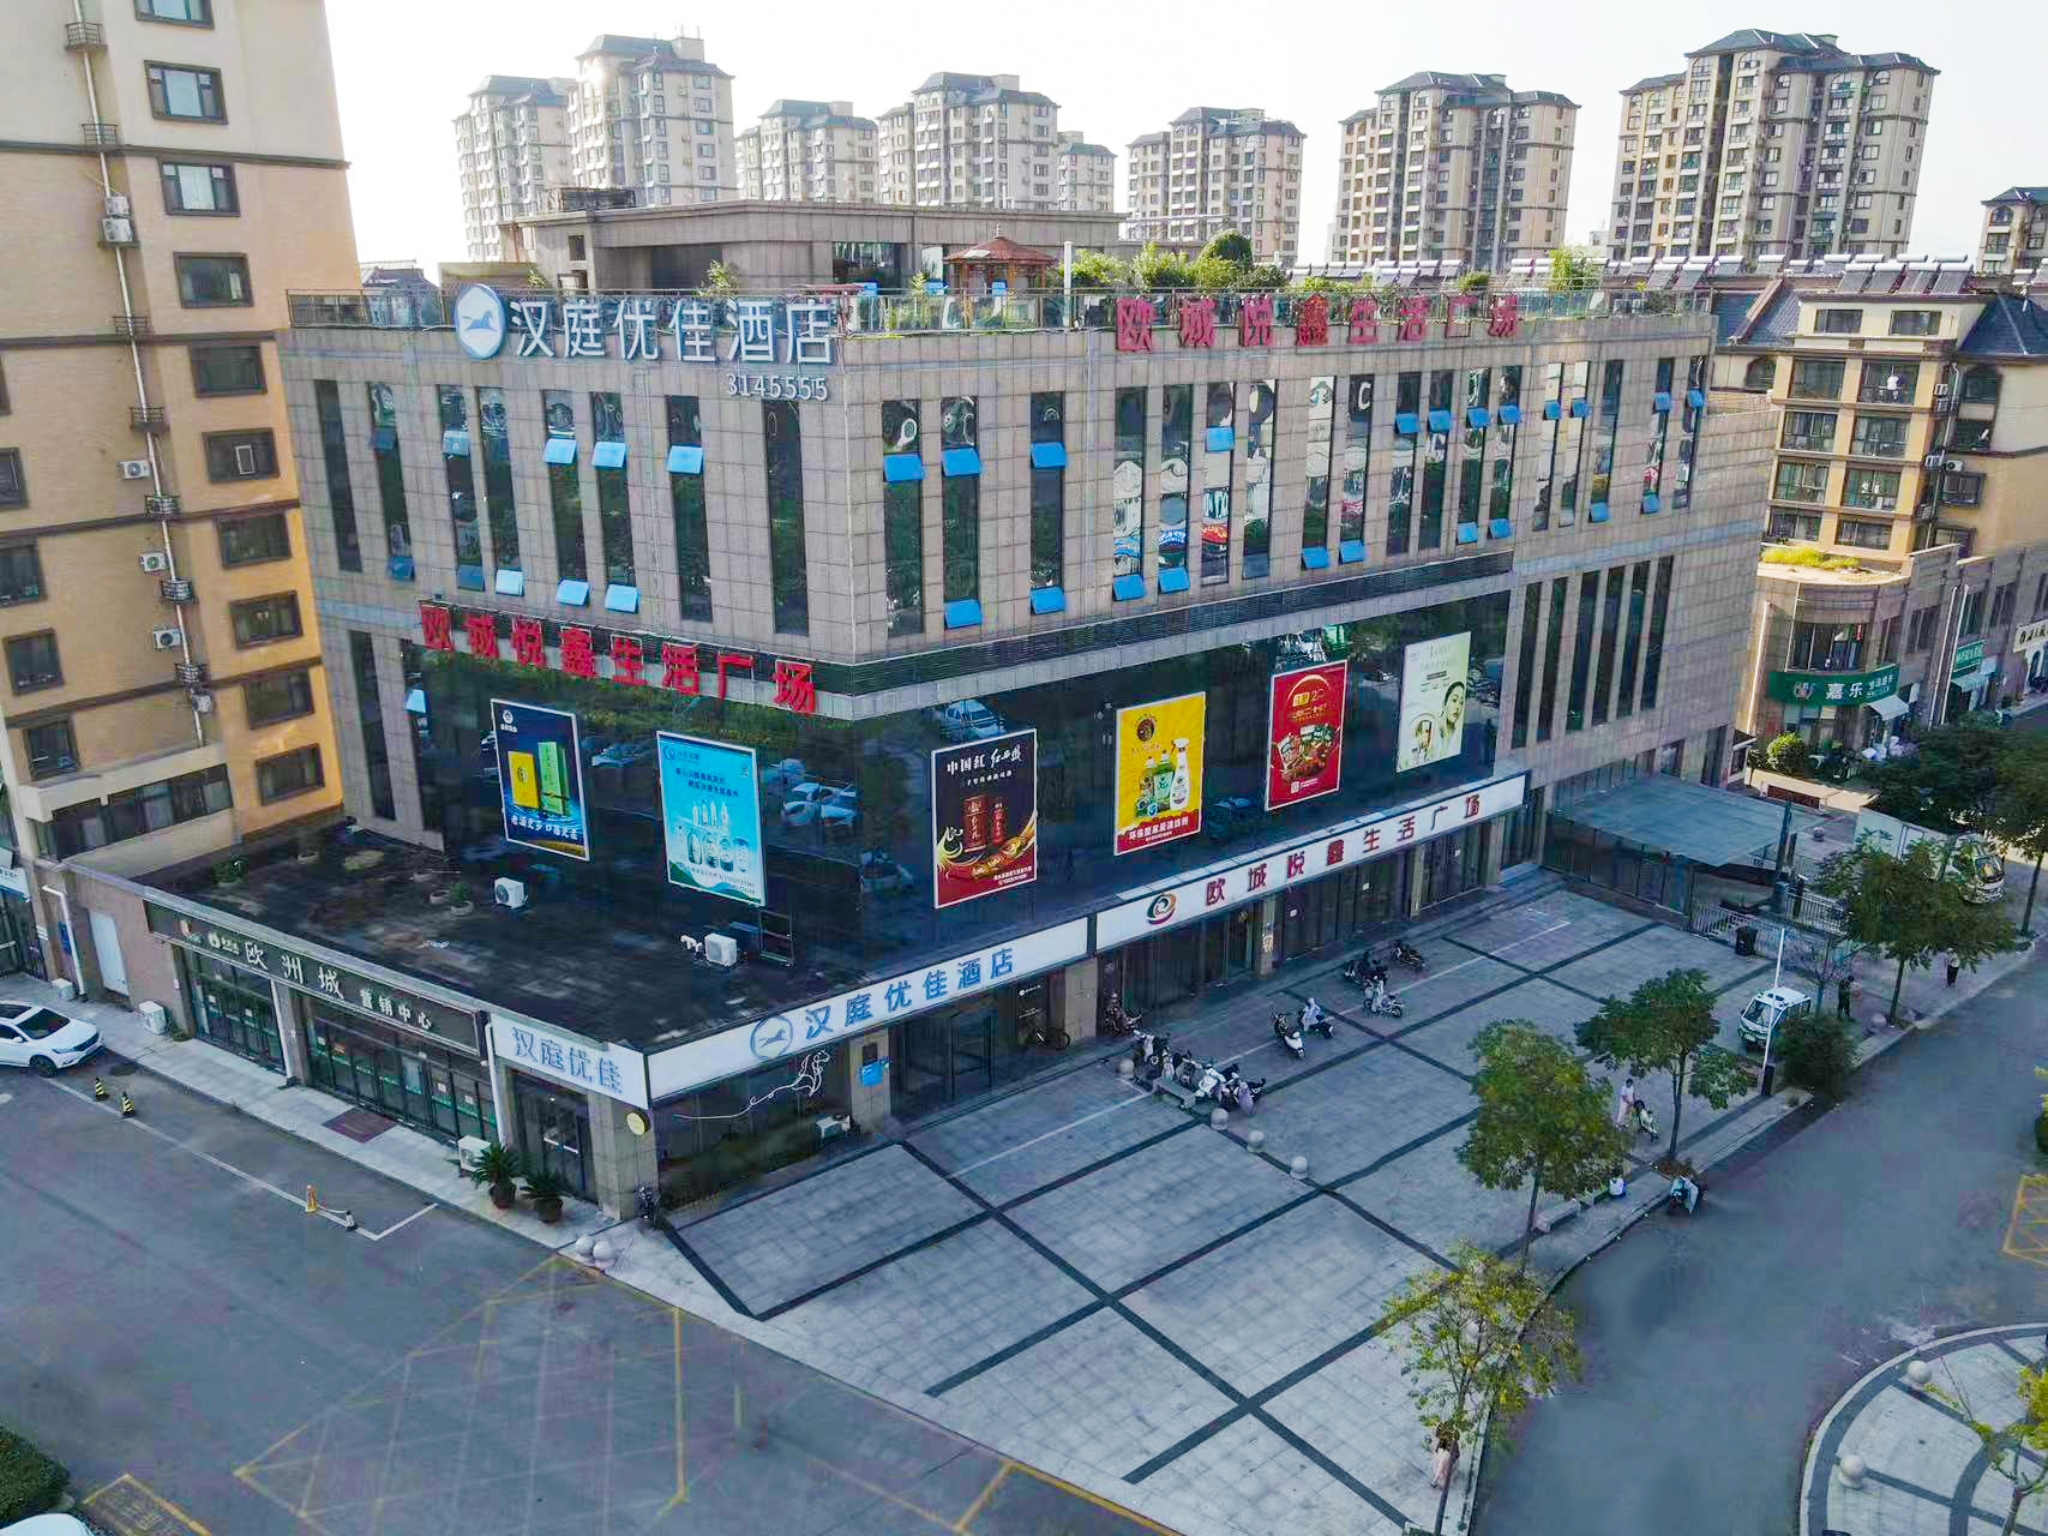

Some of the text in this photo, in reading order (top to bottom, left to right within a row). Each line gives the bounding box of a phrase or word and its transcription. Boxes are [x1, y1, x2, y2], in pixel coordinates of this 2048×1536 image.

[509, 298, 832, 364] 汉庭优佳酒店
[726, 373, 829, 402] 3145555
[420, 604, 817, 717] 欧城悦鑫生活广场
[1205, 793, 1481, 906] 欧城悦鑫生活广场
[244, 941, 345, 1000] 欧洲城
[358, 987, 432, 1031] 营销中心
[805, 947, 1014, 1041] 汉庭优佳酒店
[510, 1026, 623, 1094] 汉庭优佳
